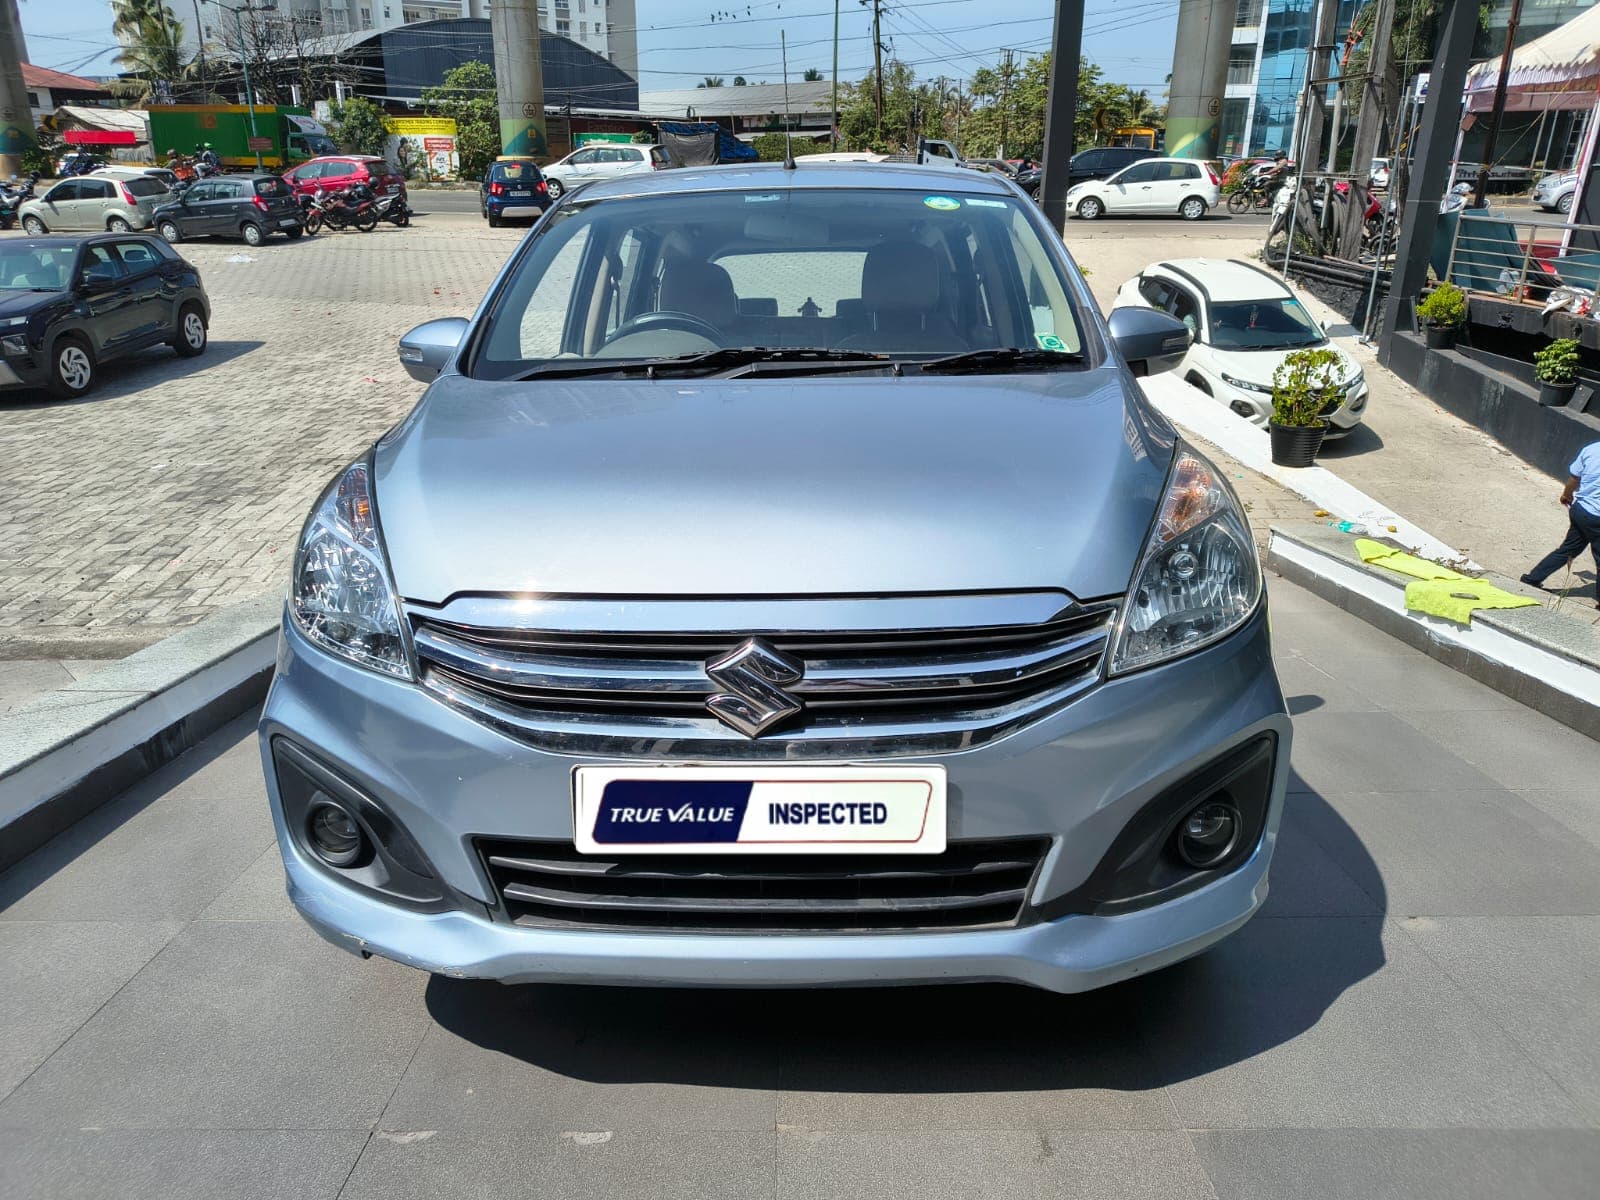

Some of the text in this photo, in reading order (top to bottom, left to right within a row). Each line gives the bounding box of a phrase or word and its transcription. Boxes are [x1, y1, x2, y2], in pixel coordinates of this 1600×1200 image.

[610, 801, 888, 825] TRUE VALUE INSPECTED
